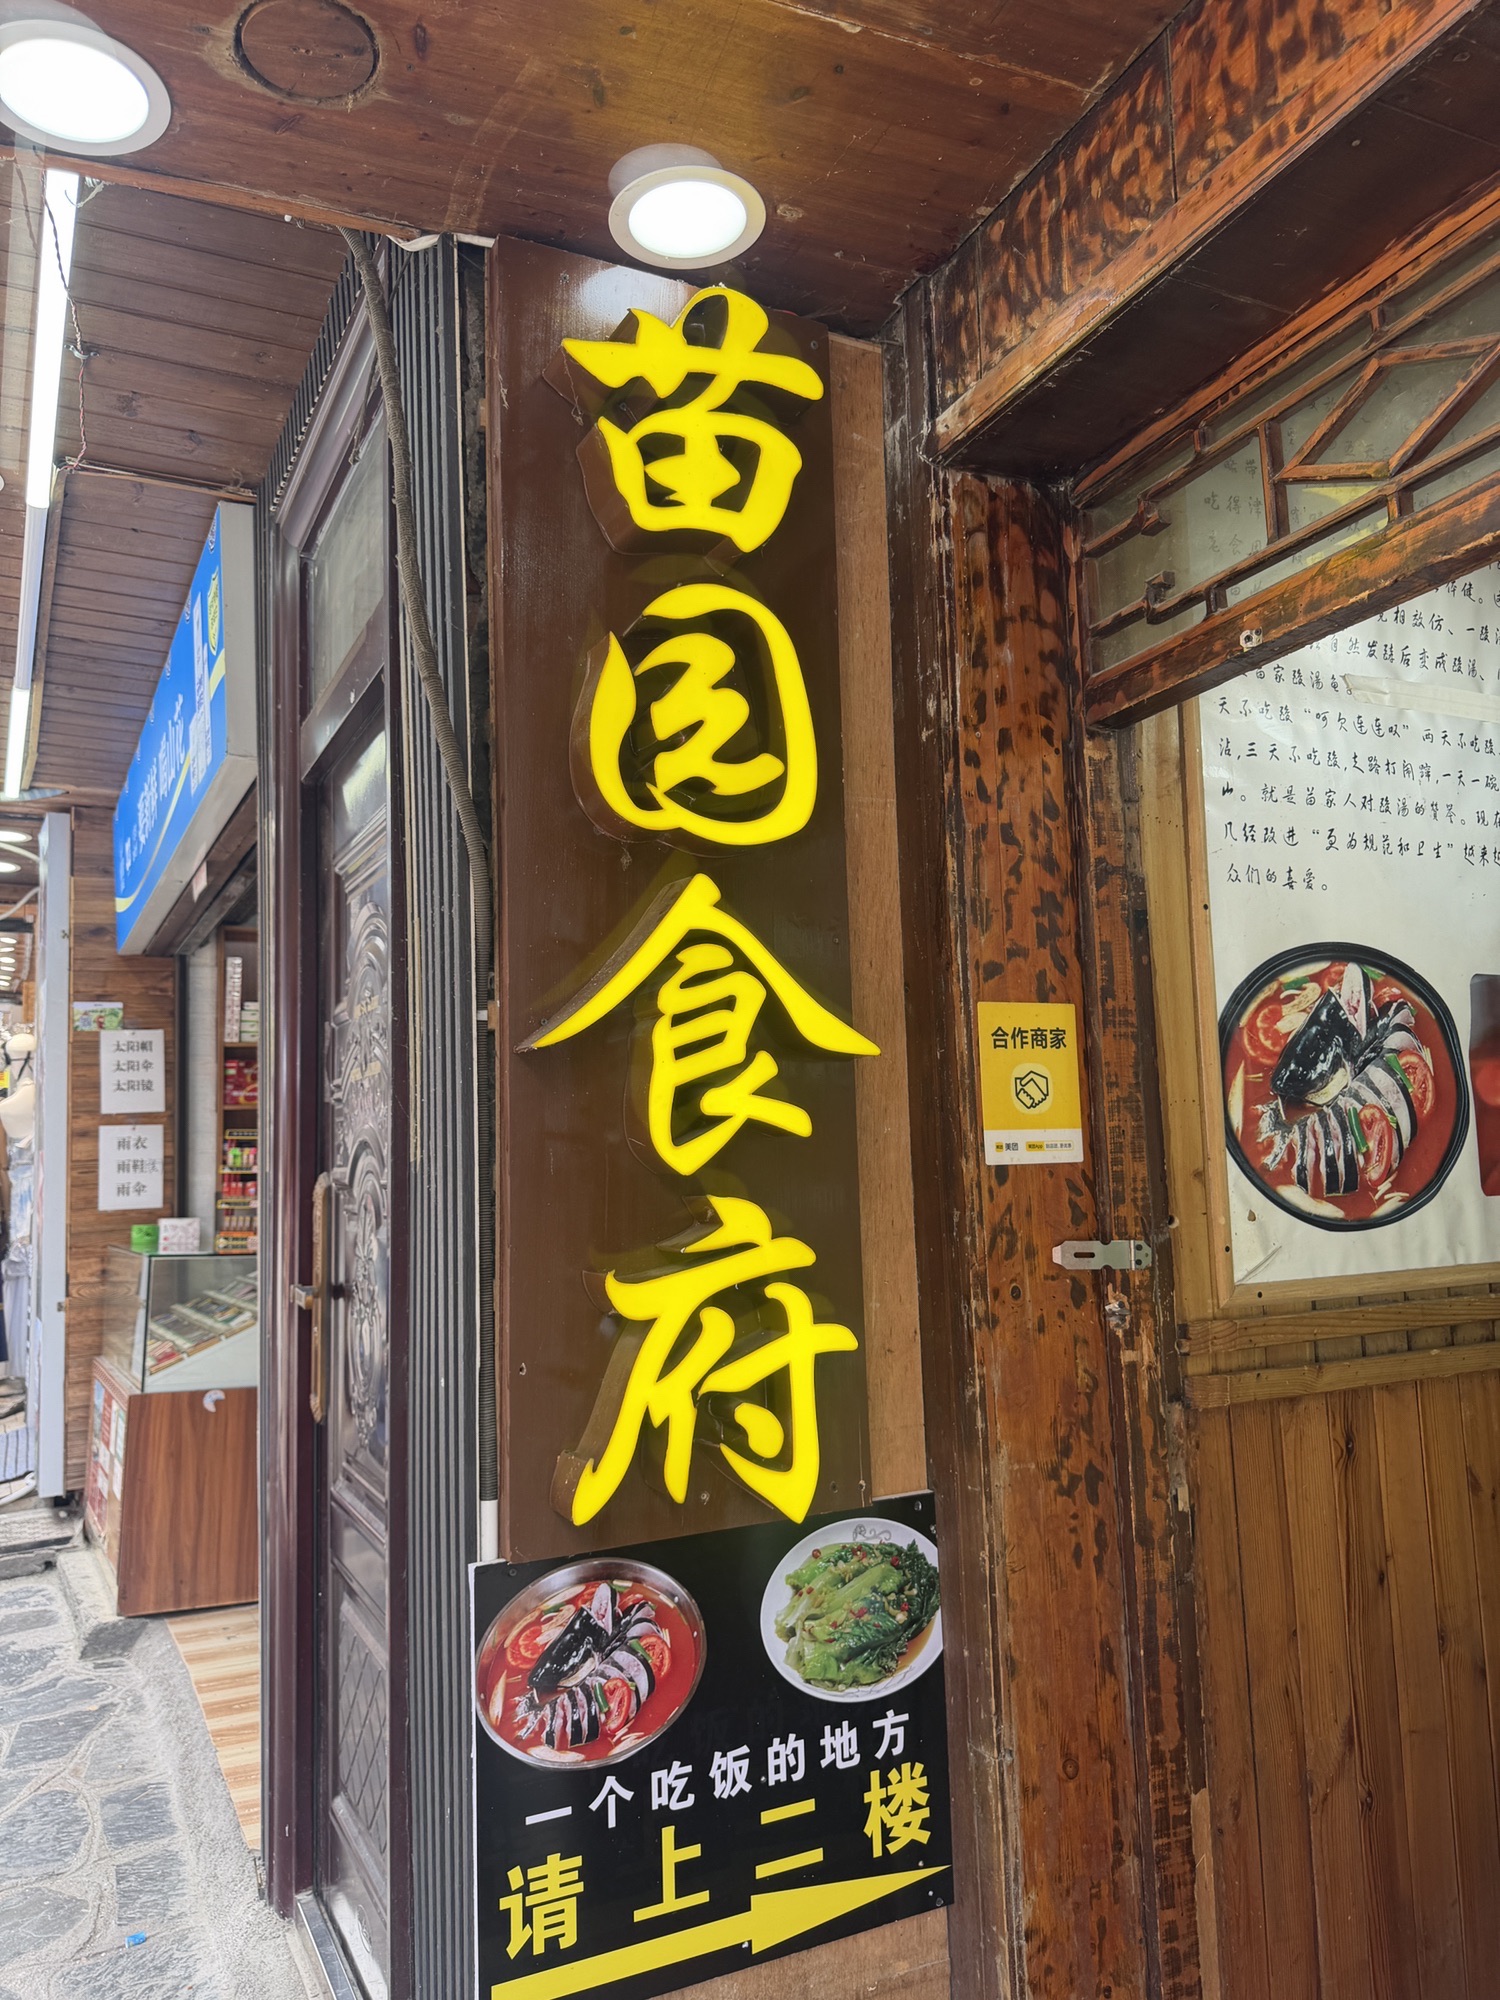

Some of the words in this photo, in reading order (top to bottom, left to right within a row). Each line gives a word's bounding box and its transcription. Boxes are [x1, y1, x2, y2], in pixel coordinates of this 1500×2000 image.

[532, 284, 880, 1526] 苗园食府
[991, 1026, 1067, 1049] 合作商家
[112, 1059, 154, 1073] 太阳伞
[112, 1079, 154, 1092] 太阳镜
[116, 1136, 148, 1150] 雨衣
[1005, 1142, 1019, 1151] 美团
[116, 1181, 147, 1197] 雨伞
[525, 1709, 910, 1829] 一个吃饭的地方
[499, 1762, 932, 1960] 请上二楼
